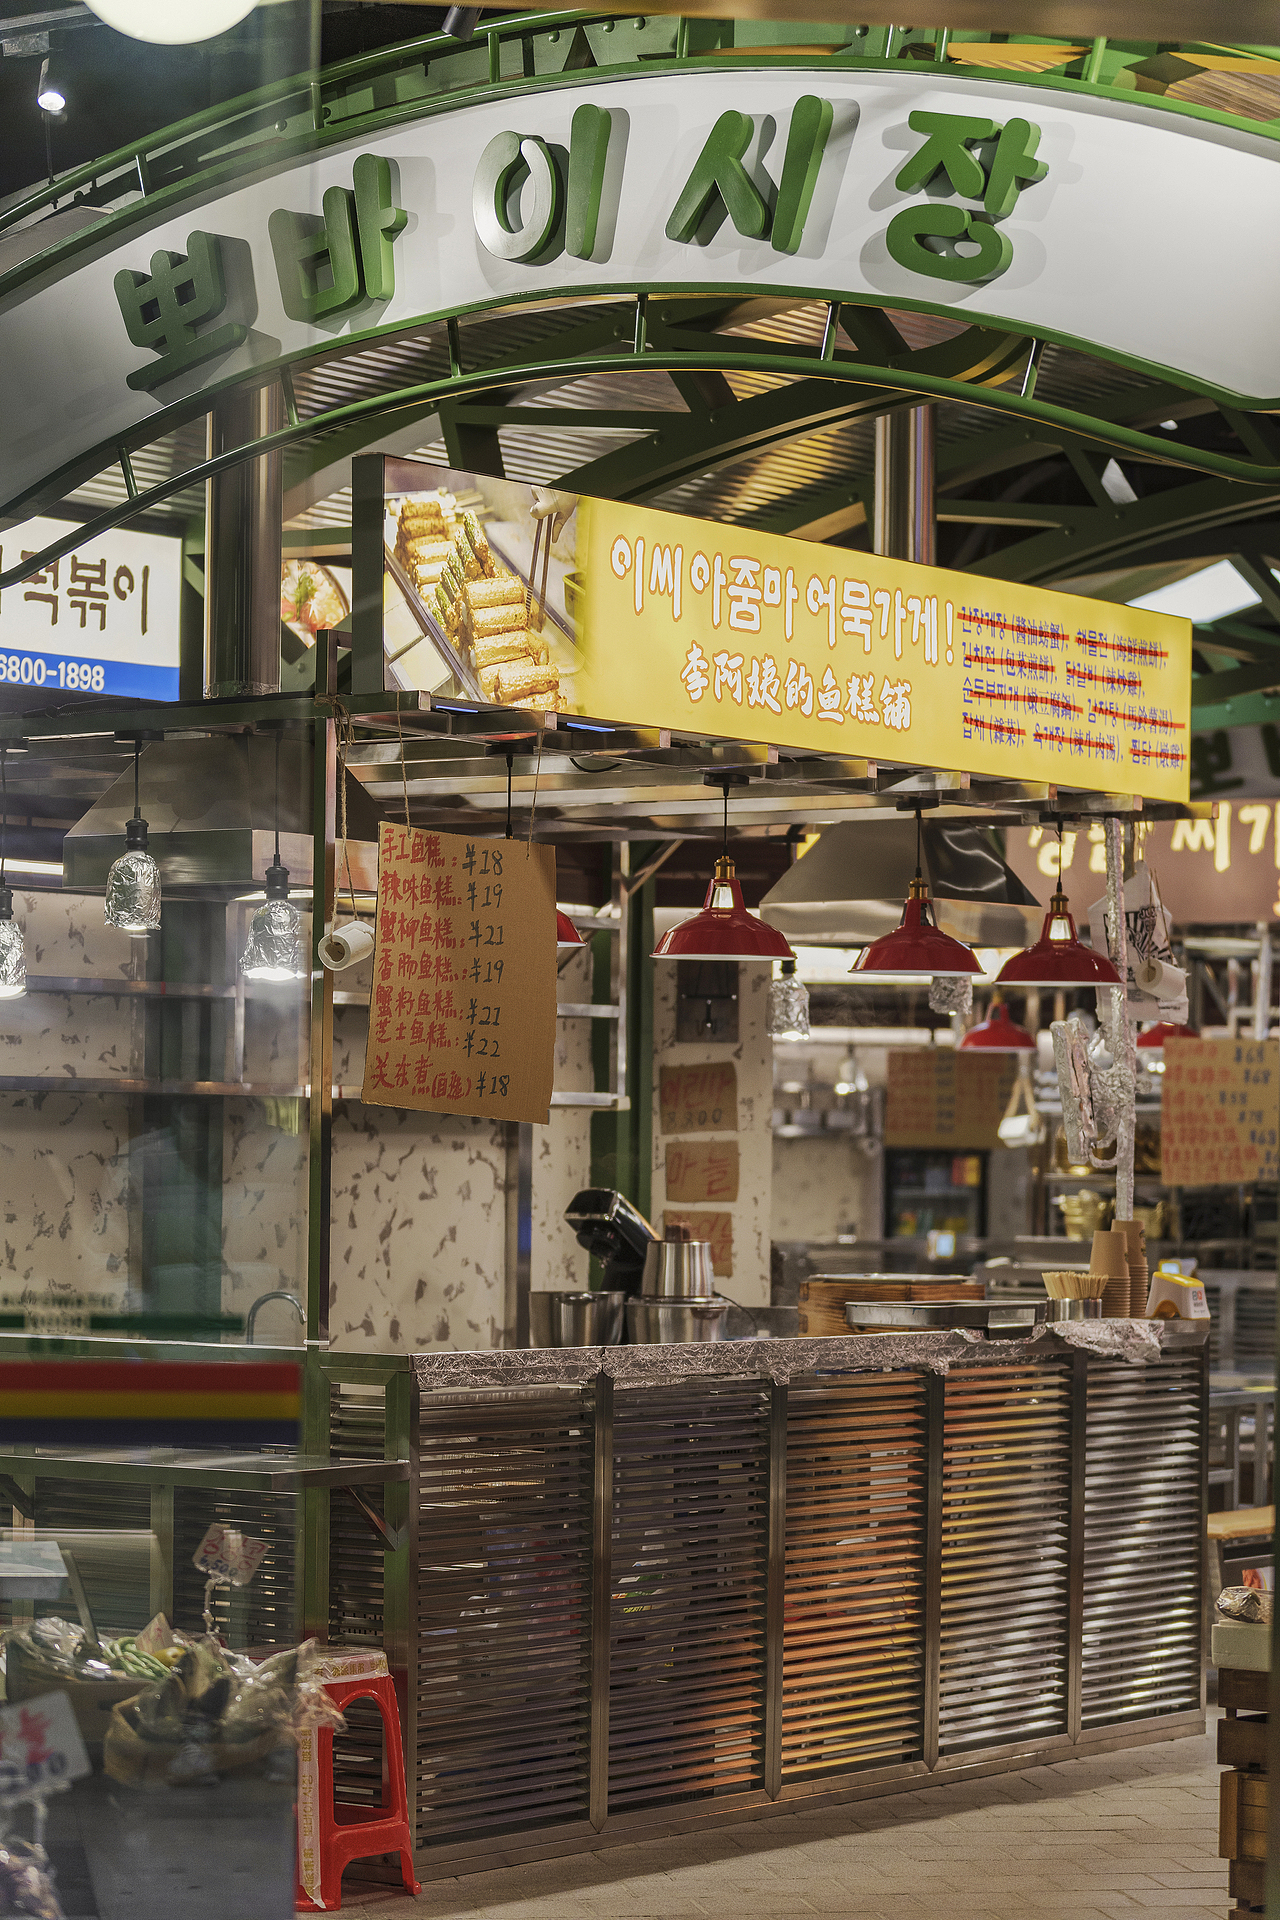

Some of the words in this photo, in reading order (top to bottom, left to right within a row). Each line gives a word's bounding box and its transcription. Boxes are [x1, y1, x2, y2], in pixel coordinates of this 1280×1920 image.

[610, 535, 683, 622] 이씨
[689, 552, 798, 643] 아줌마
[806, 573, 954, 667] 어묵가게!
[680, 640, 912, 732] 李阿姨的鱼糕铺
[462, 843, 503, 876] ¥18
[466, 881, 503, 911] ¥19
[468, 919, 504, 948] ¥21
[469, 957, 505, 984] ¥19
[466, 998, 501, 1026] ¥21
[462, 1030, 501, 1058] ¥22
[475, 1070, 510, 1098] ¥18
